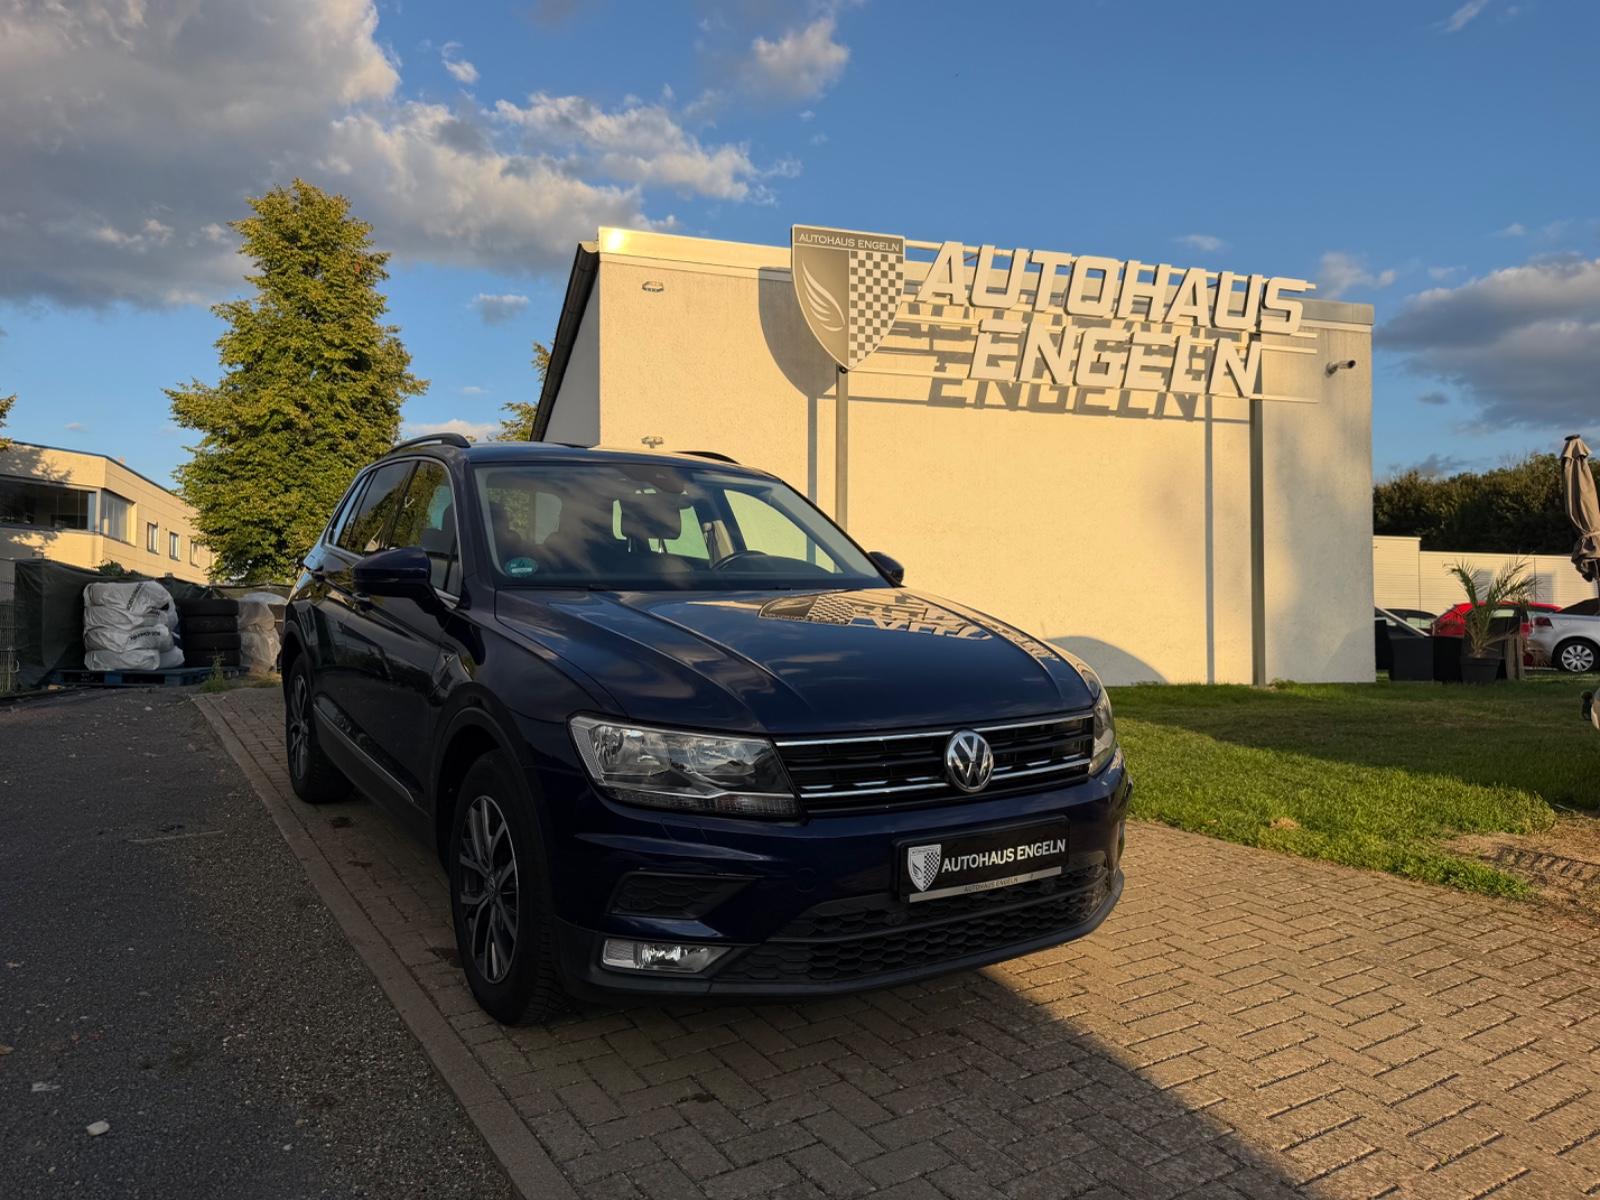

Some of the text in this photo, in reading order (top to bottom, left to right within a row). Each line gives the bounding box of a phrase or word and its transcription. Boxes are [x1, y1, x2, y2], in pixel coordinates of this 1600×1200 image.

[799, 234, 899, 251] AUTOHAUS ENGELN
[916, 241, 1309, 334] AUTOHAUS
[968, 319, 1262, 398] ENGELN
[941, 839, 1067, 873] AUTOHAUS ENGELN
